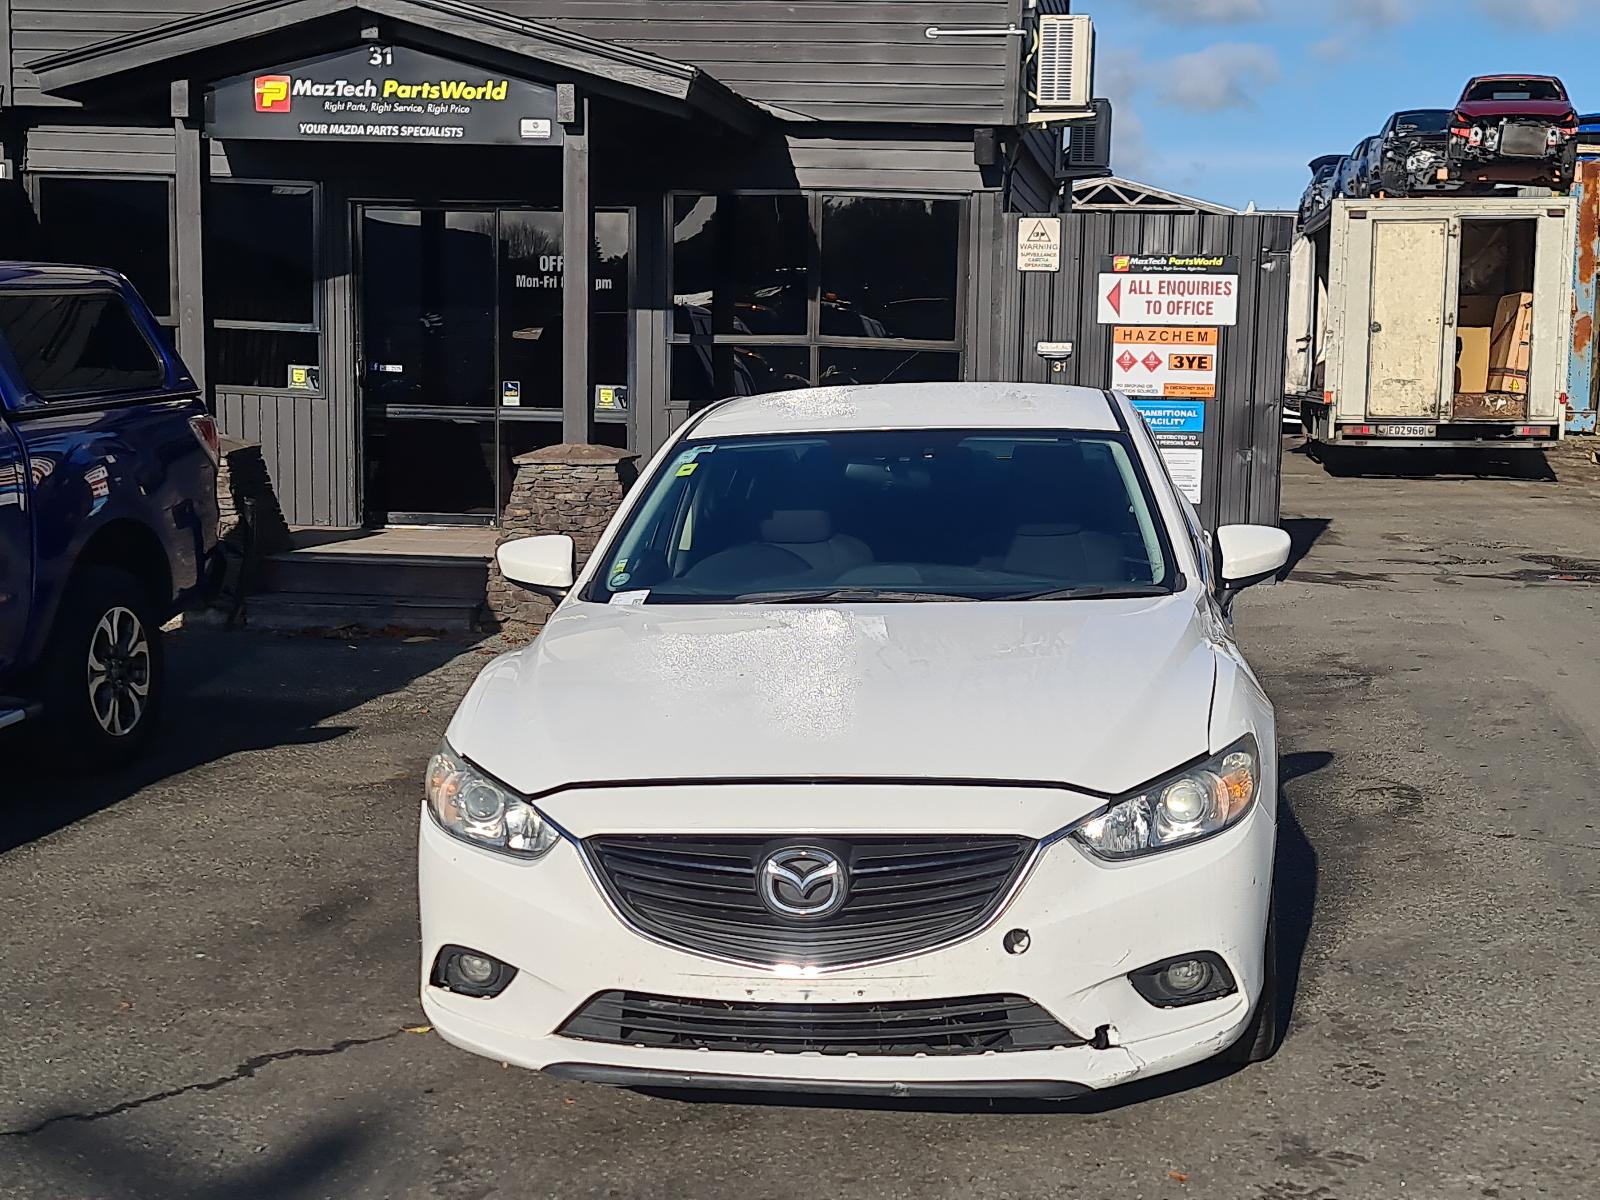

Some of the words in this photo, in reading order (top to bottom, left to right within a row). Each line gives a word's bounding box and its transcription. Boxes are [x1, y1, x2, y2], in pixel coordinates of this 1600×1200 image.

[368, 47, 393, 65] 31
[292, 79, 377, 98] MazTech
[382, 79, 508, 100] PartsWorld
[324, 101, 345, 113] Right
[346, 101, 369, 113] Parts,
[370, 102, 392, 114] Right
[393, 102, 425, 114] Service,
[427, 103, 448, 115] Right
[449, 104, 471, 114] Price
[299, 123, 328, 134] YOUR
[329, 124, 365, 135] MAZDA
[366, 125, 399, 136] PARTS
[400, 126, 464, 138] SPECIALISTS
[539, 255, 564, 272] OFF
[1129, 256, 1167, 265] MazTech
[1168, 256, 1223, 266] PartsWorld
[515, 274, 557, 289] Mon-Fri
[1128, 280, 1153, 295] ALL
[1158, 280, 1233, 296] ENQUIRIES
[1145, 300, 1162, 315] TO
[1166, 301, 1214, 316] OFFICE
[1123, 329, 1208, 342] HAZCHEM
[1052, 360, 1067, 373] 31
[1173, 355, 1208, 369] 3YE
[1145, 417, 1185, 426] FACILITY
